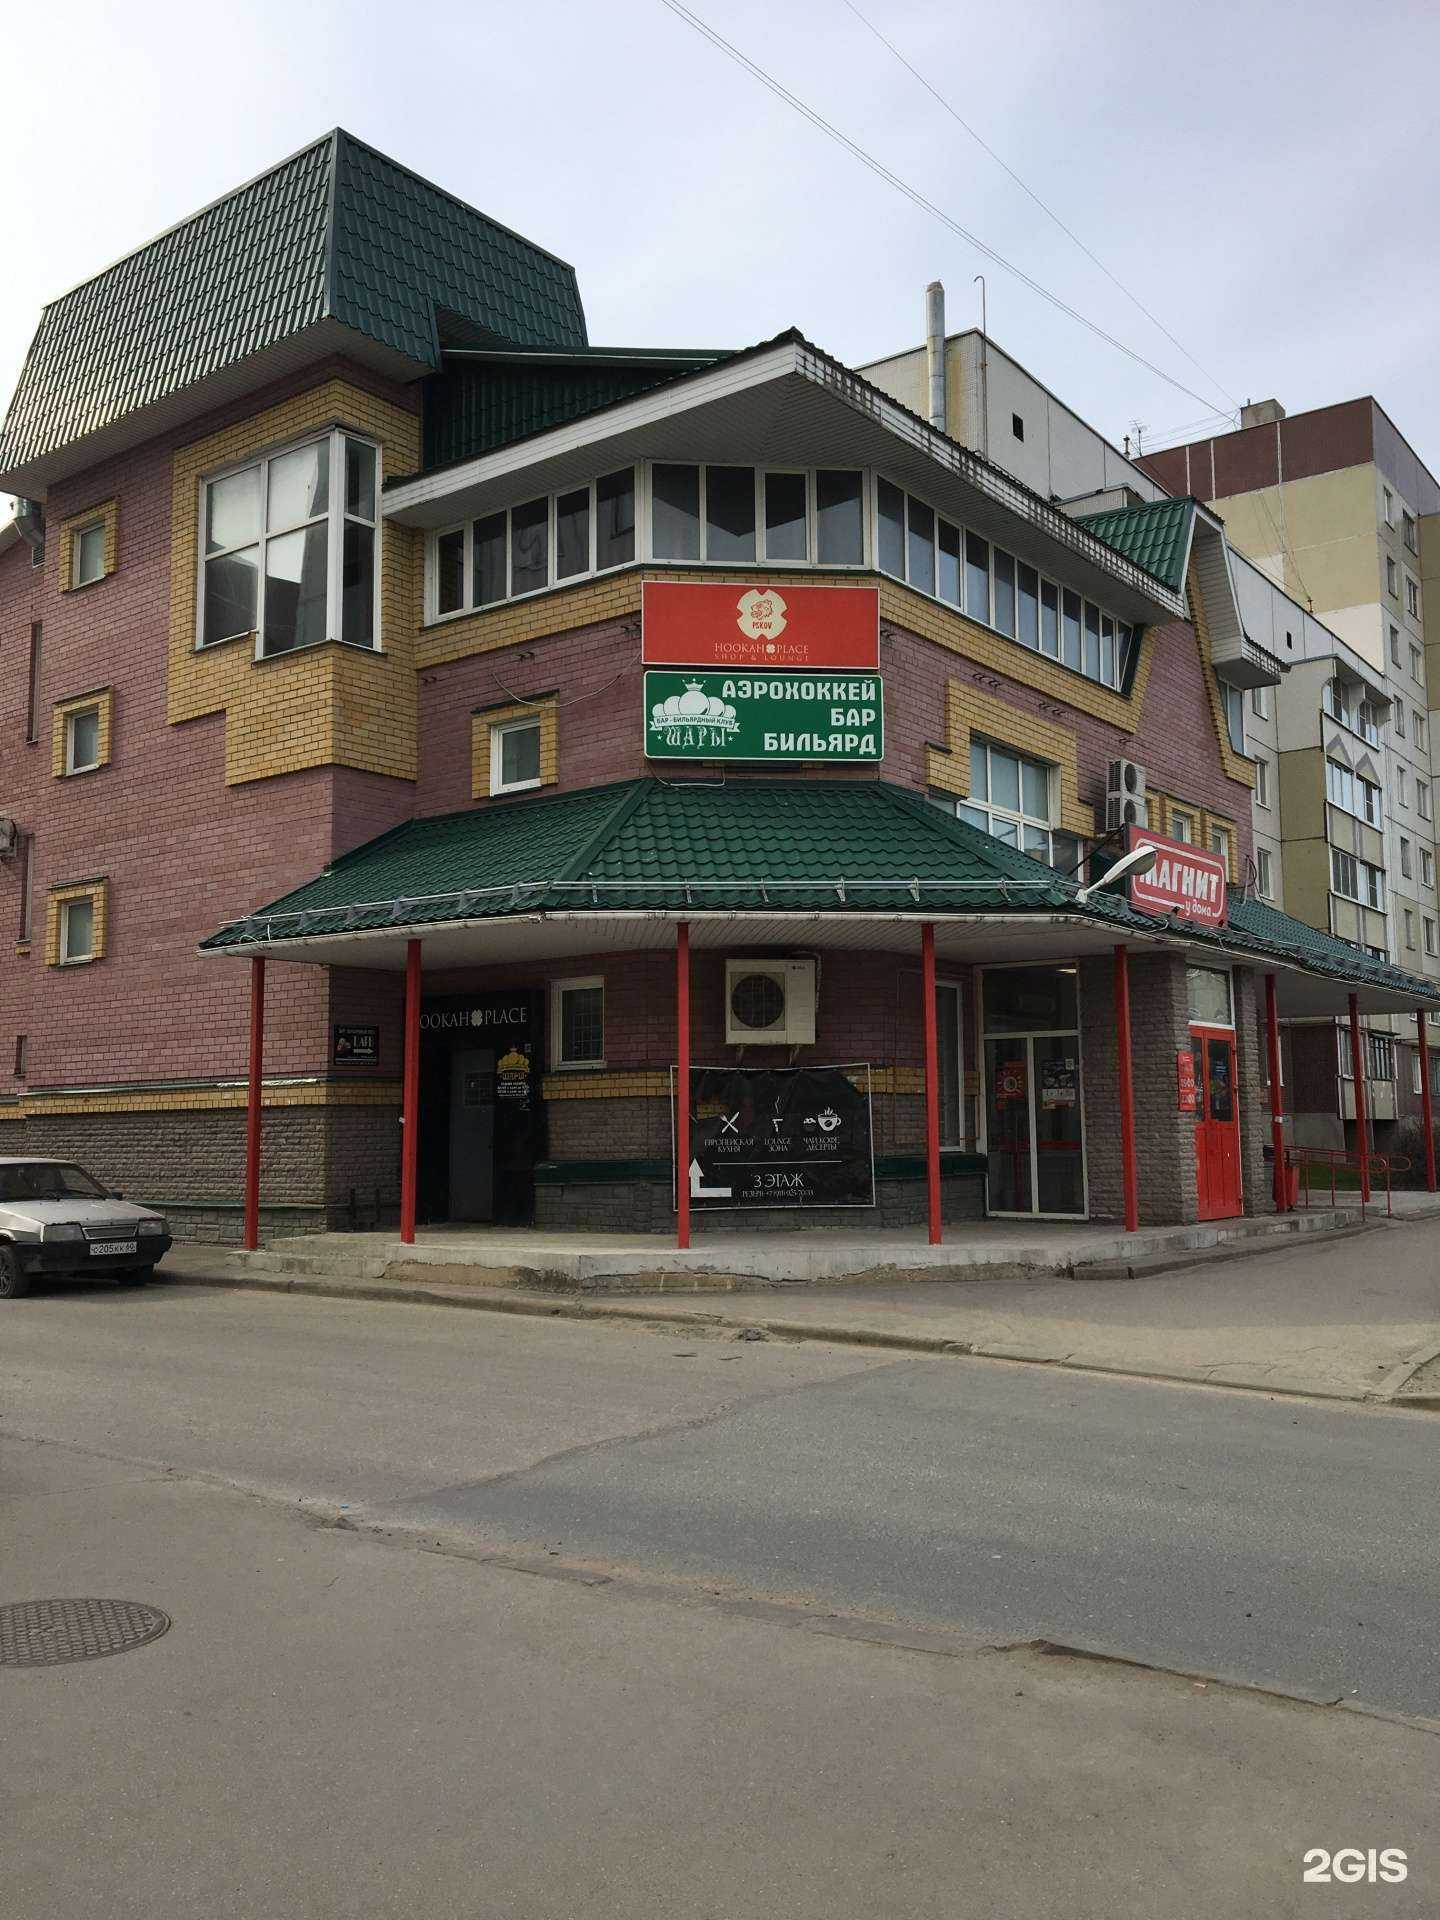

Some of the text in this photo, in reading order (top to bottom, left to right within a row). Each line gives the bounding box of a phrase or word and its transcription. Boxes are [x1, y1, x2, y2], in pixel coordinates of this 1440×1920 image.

[714, 642, 809, 654] HOOKAH PLACE
[722, 680, 876, 701] АЭРОХОККЕЙ
[830, 708, 876, 726] БАР
[663, 726, 727, 749] ШАРЫ
[764, 733, 876, 754] БИЛЬЯРД
[420, 1007, 527, 1029] OOKAH PLACE
[754, 1173, 804, 1188] 3 ЭТАЖ
